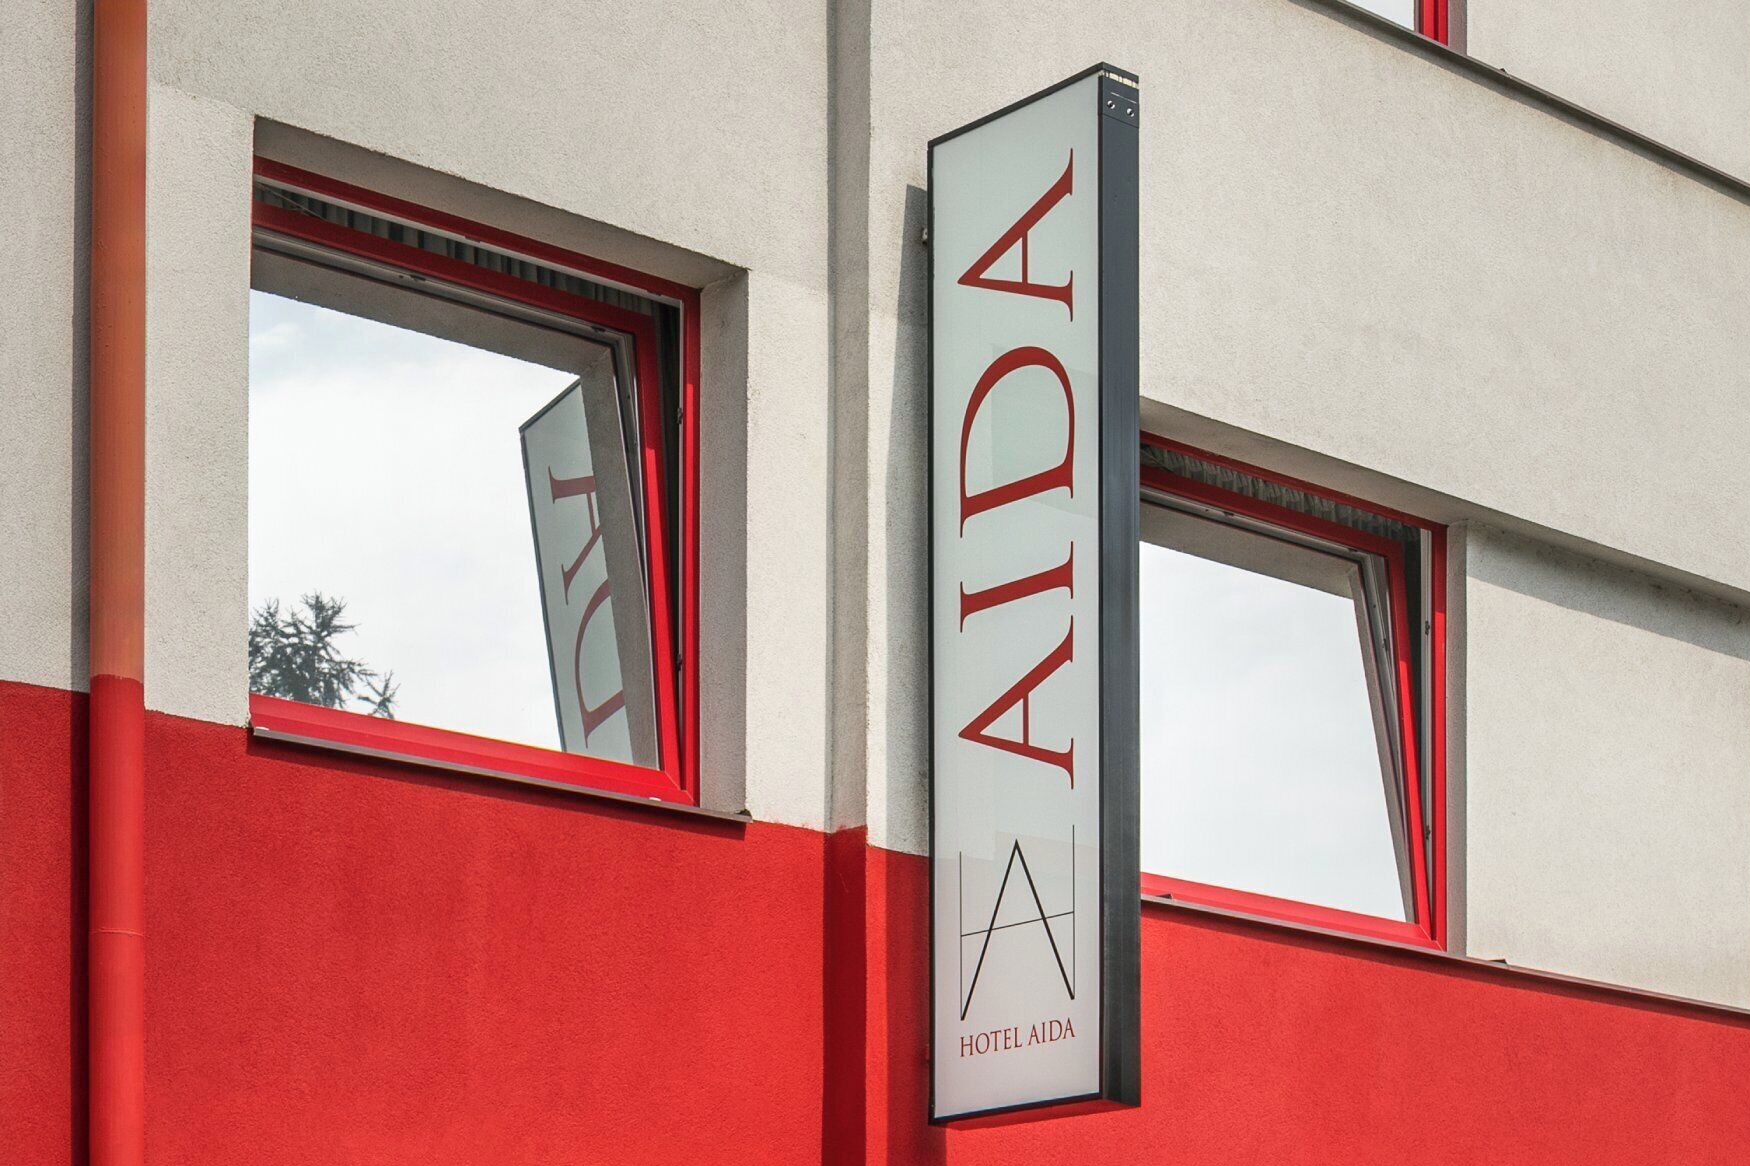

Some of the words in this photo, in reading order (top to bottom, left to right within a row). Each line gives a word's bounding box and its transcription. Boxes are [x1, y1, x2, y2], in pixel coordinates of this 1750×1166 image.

[957, 148, 1075, 789] AIDA
[960, 1027, 1022, 1057] HOTEL
[1027, 1017, 1075, 1046] AIDA
